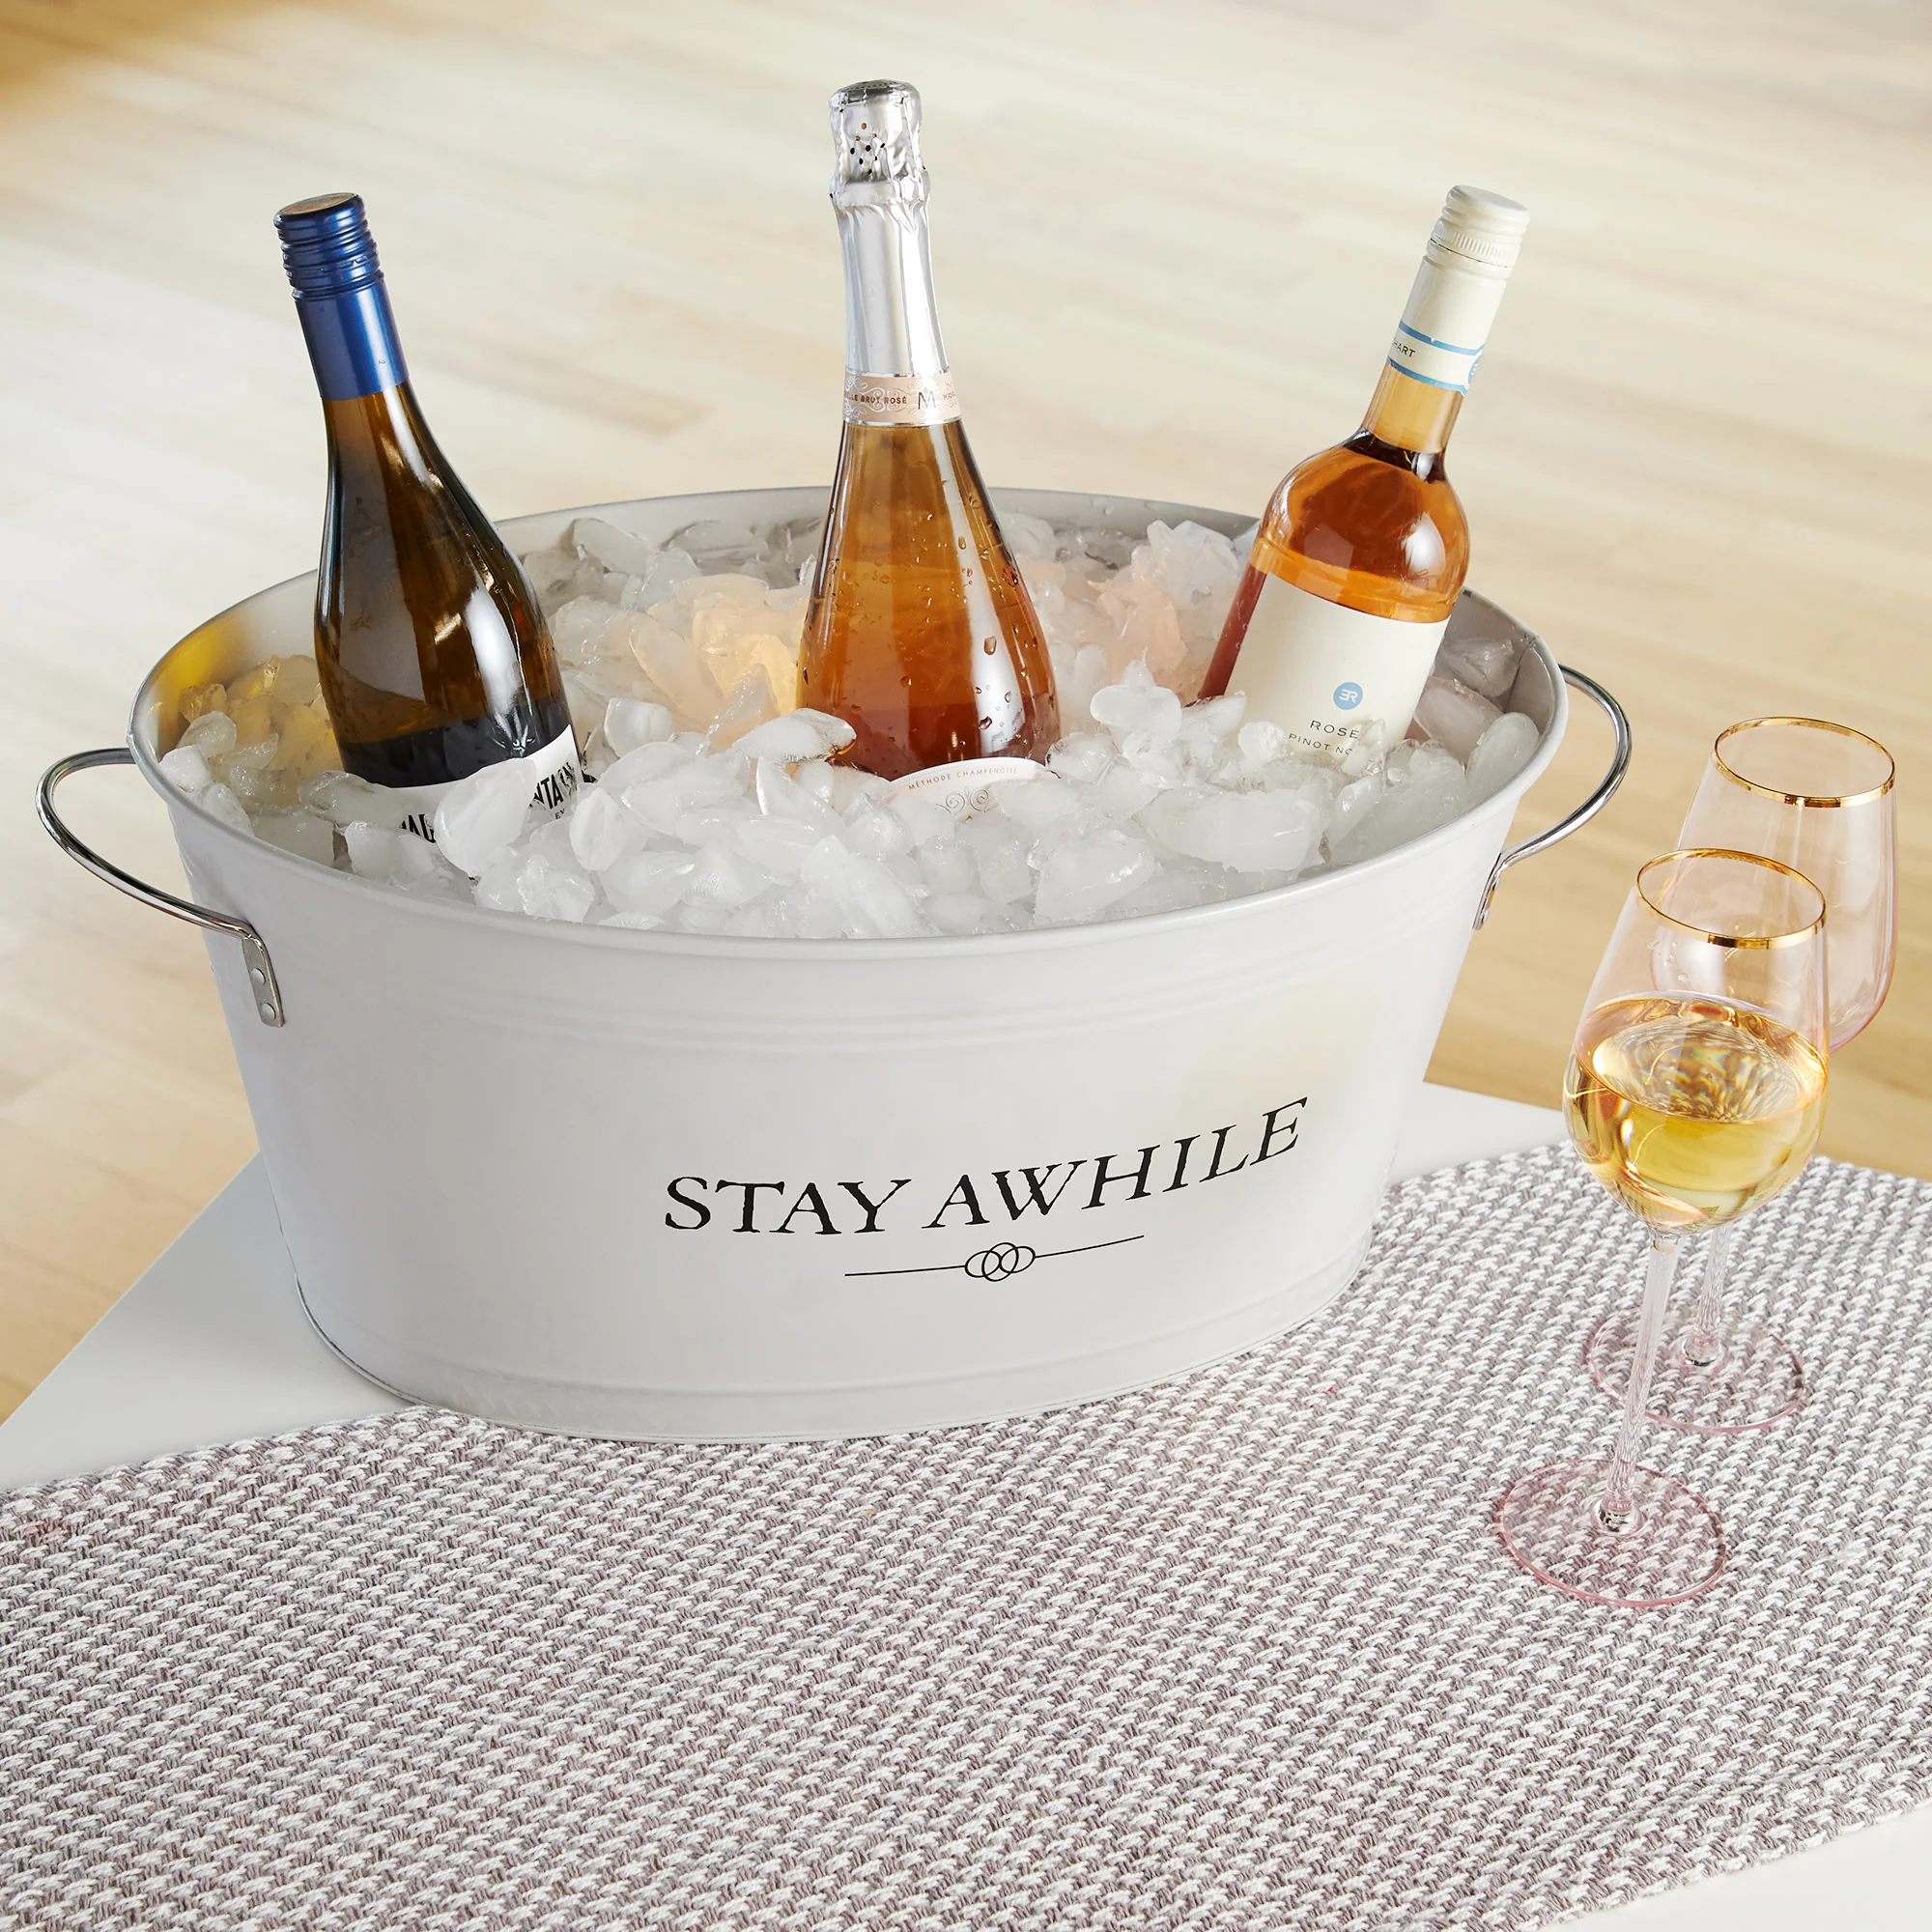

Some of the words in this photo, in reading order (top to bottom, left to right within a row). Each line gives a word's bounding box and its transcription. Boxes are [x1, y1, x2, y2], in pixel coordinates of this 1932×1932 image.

[860, 395, 881, 404] BRUT
[883, 396, 908, 405] ROSÉ
[1288, 732, 1331, 751] PINOT
[1335, 746, 1352, 755] NO
[956, 767, 1017, 779] CHAMPENOISE
[666, 1177, 911, 1235] STAY
[922, 1097, 1307, 1229] AWHILE
